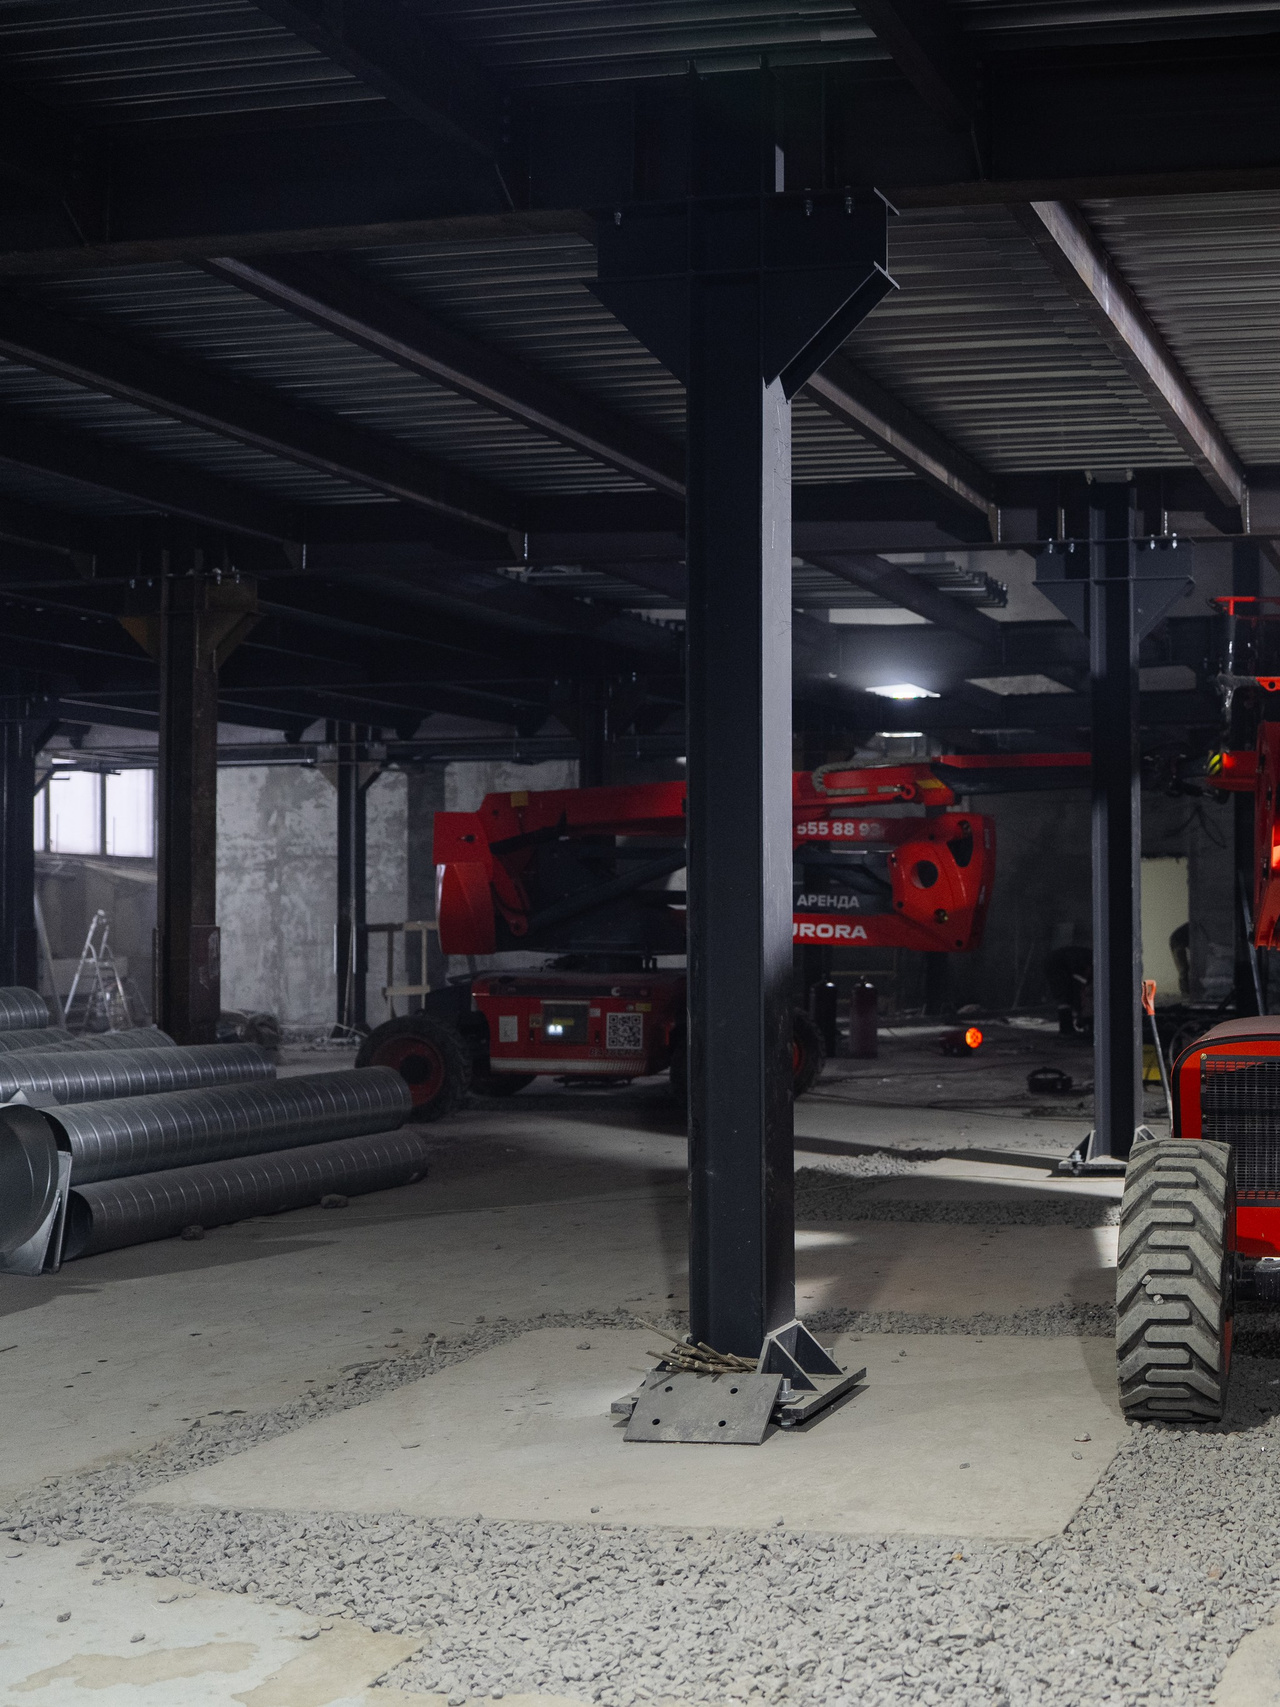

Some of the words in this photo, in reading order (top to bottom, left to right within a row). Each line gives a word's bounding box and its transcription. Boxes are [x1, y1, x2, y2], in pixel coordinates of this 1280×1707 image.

[796, 821, 829, 836] 555
[832, 822, 855, 836] 88
[796, 894, 860, 909] АРЕНДА
